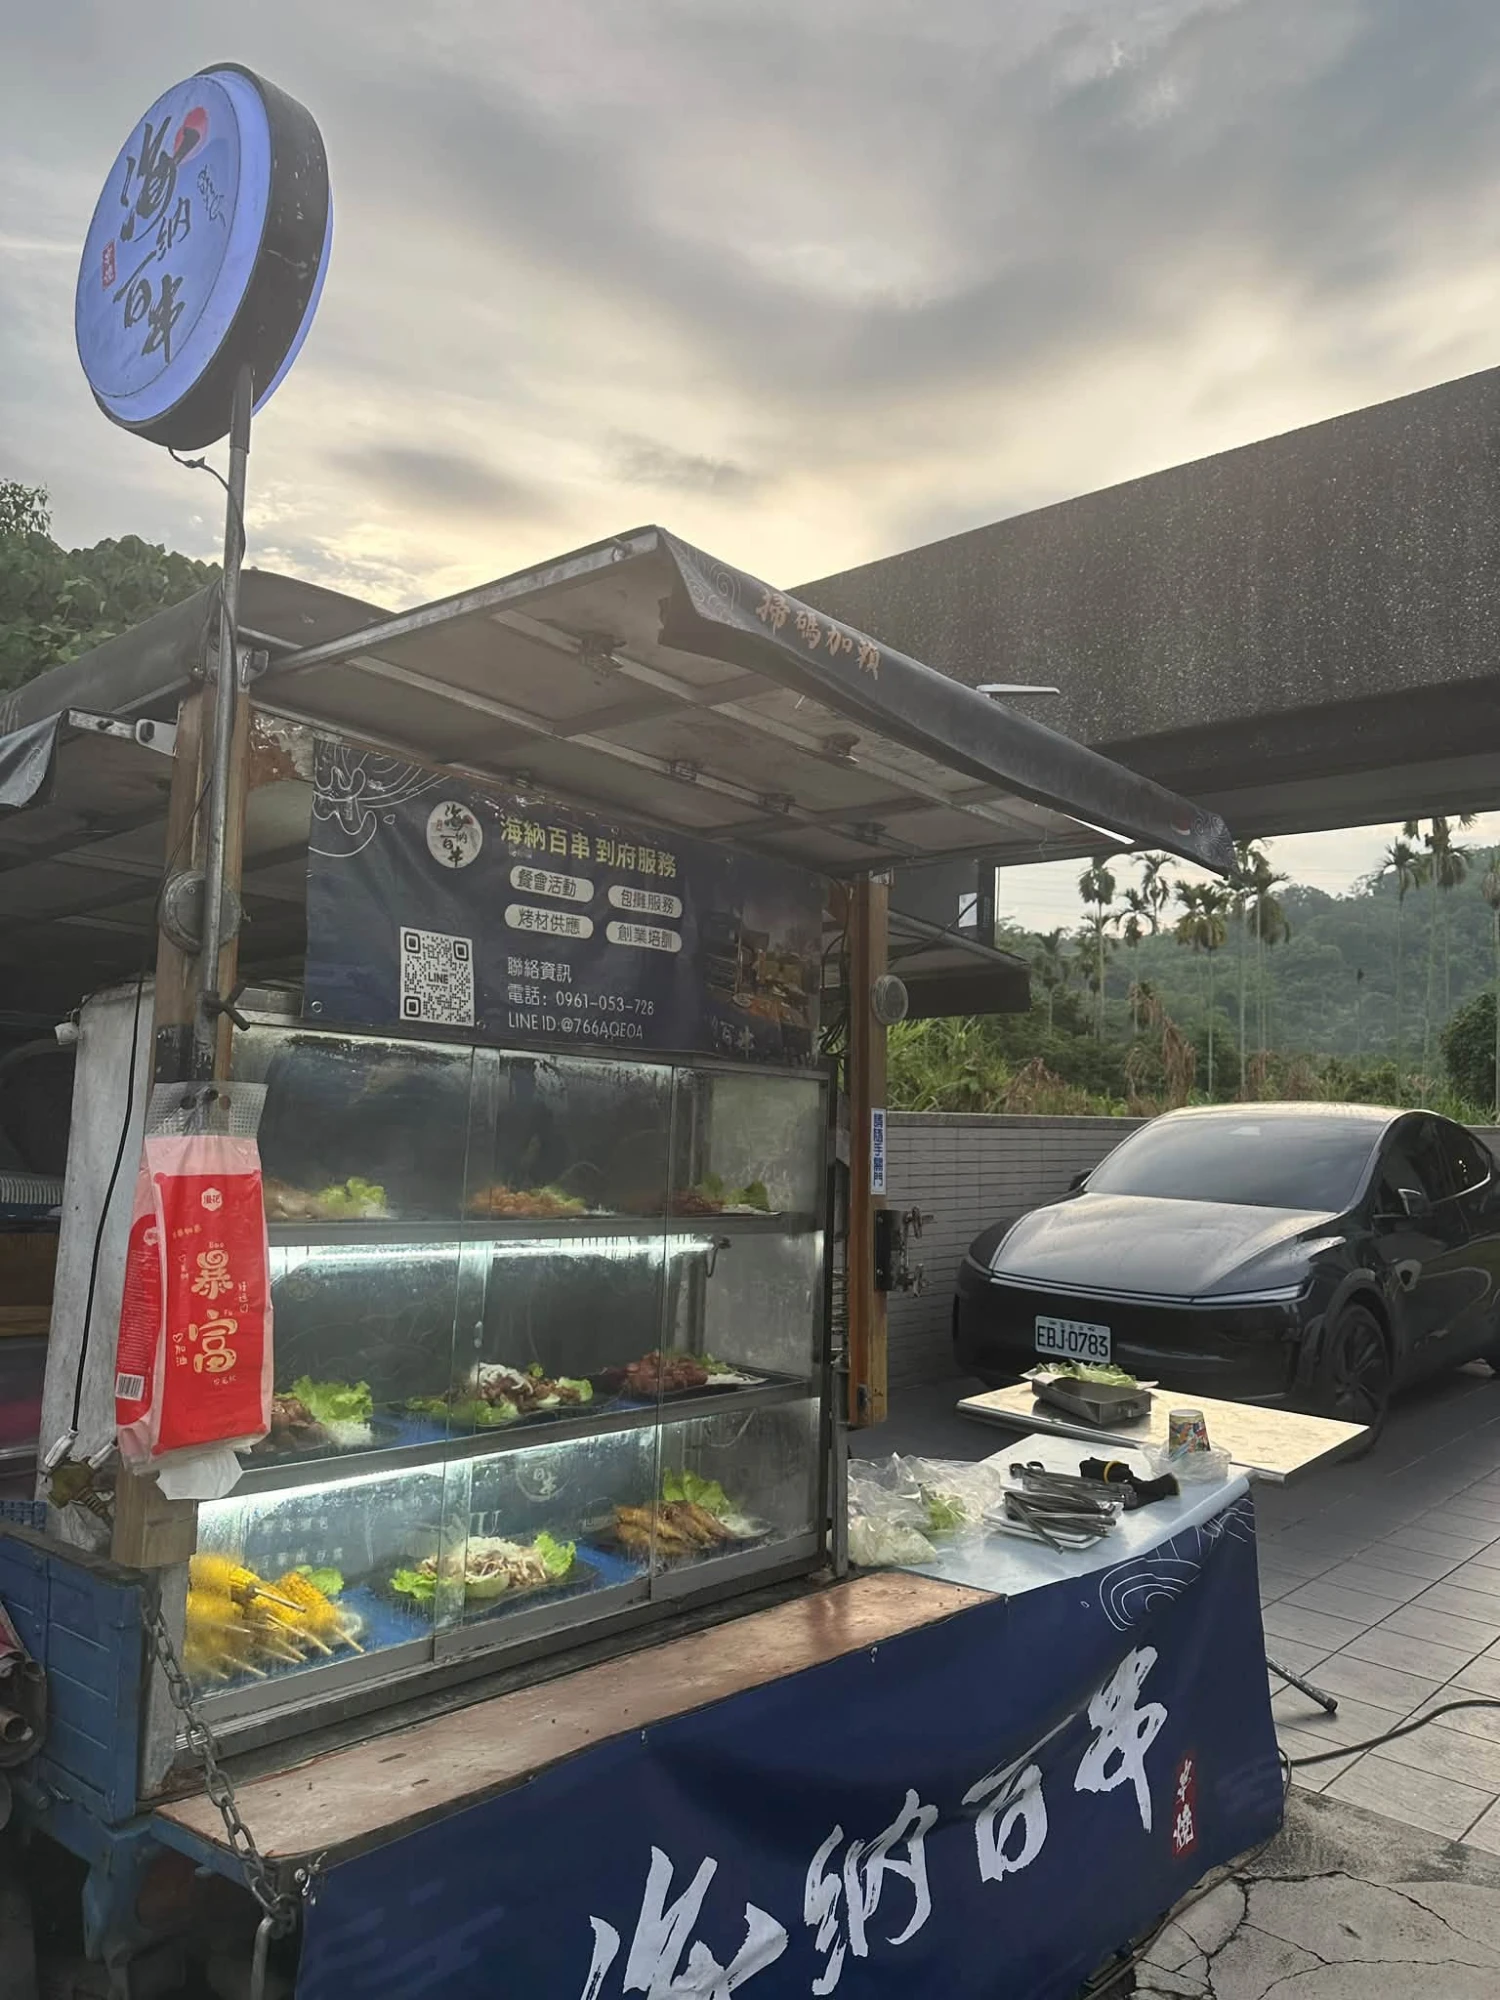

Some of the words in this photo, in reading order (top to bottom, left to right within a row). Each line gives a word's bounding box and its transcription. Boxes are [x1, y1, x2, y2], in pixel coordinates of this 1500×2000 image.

[500, 814, 590, 860] 海納百串
[596, 836, 677, 878] 到府服務
[517, 868, 577, 898] 餐會活動
[621, 888, 674, 915] 包攤服務
[517, 907, 581, 935] 烤材供應
[617, 923, 673, 949] 創業培訓
[428, 972, 449, 985] LINE
[507, 956, 572, 984] 聯絡資訊
[556, 990, 655, 1016] 0961-053-728
[508, 1011, 538, 1031] LINE
